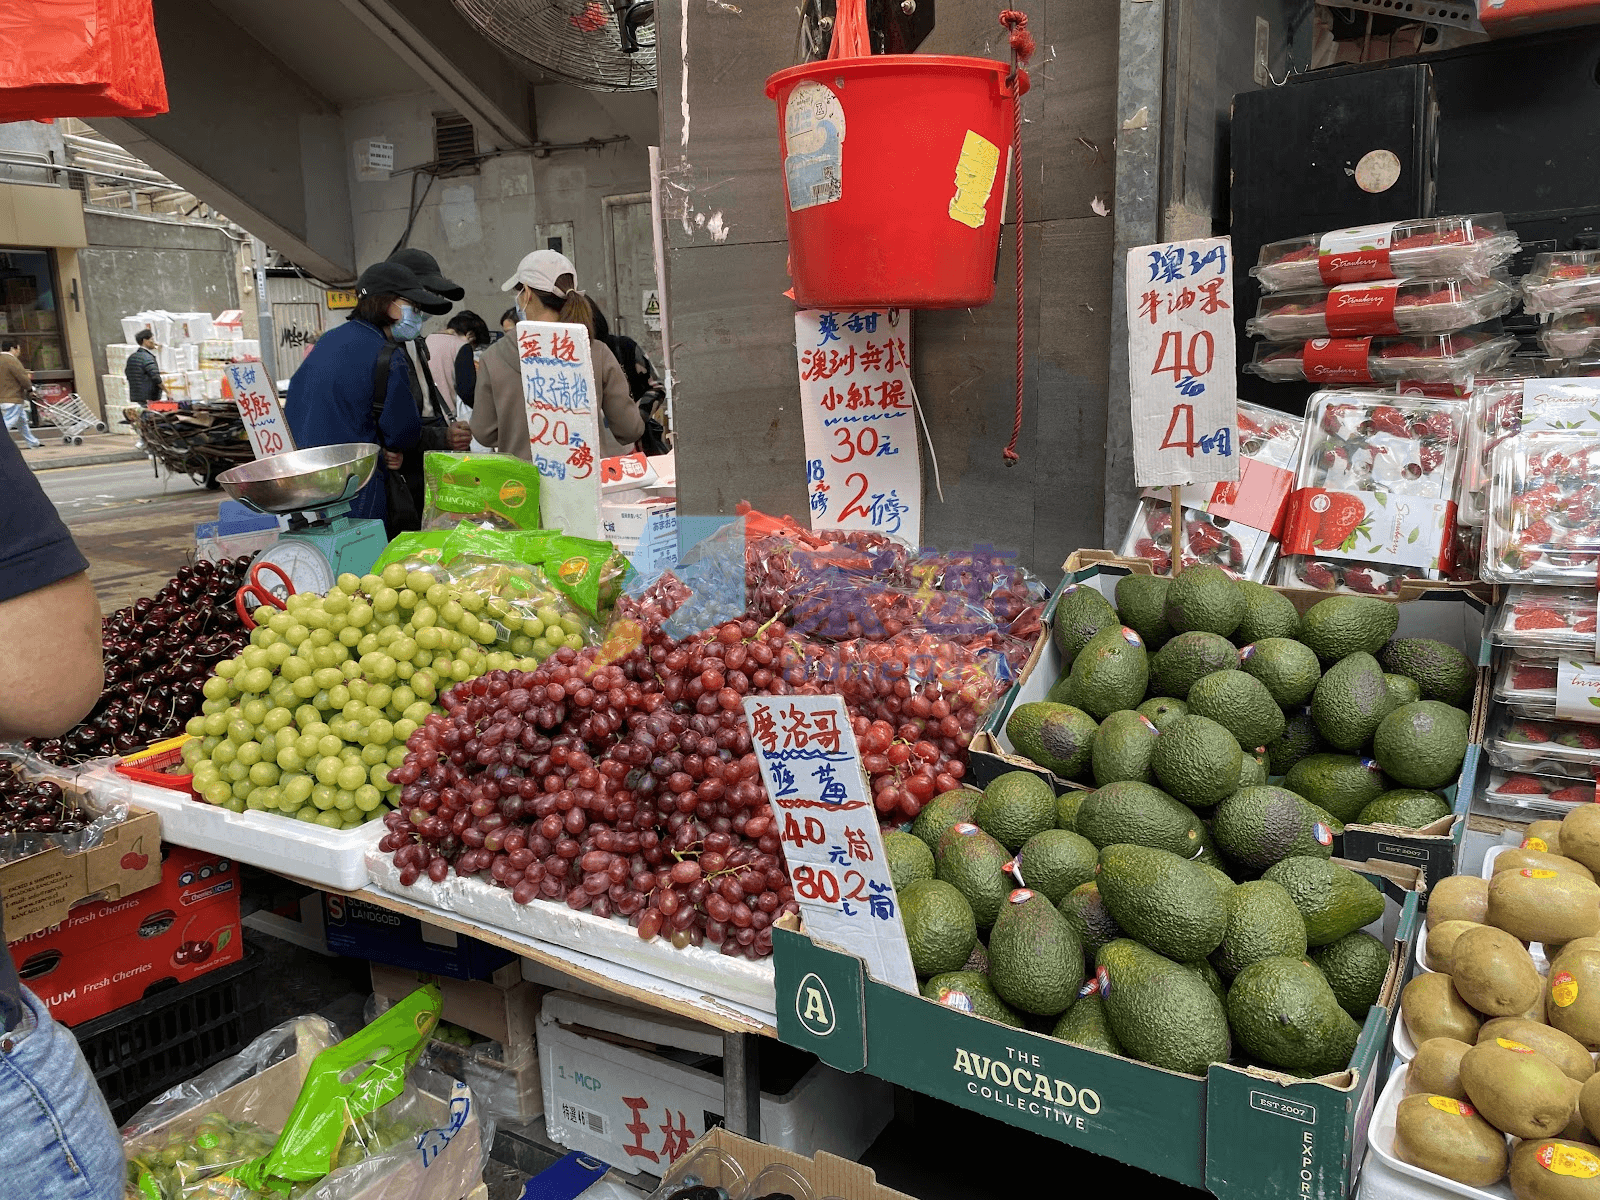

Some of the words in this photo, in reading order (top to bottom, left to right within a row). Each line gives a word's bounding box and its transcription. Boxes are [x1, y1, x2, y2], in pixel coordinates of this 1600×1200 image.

[1330, 256, 1378, 271] Strawberry
[1137, 277, 1231, 325] 牛油果
[1337, 293, 1385, 308] Strawberry
[254, 429, 283, 454] 120
[752, 703, 841, 753] 摩洛哥
[67, 911, 96, 929] Fresh
[98, 898, 140, 918] Cherries
[351, 909, 400, 926] LANDGOED
[83, 976, 110, 994] Fresh
[112, 962, 152, 983] Cherries
[803, 986, 829, 1024] A
[1005, 1046, 1041, 1068] THE
[558, 1064, 602, 1092] 1-MCP
[952, 1047, 1102, 1116] AVOCADO
[966, 1081, 1086, 1131] COLLECTIVE
[1259, 1098, 1280, 1109] EST
[1280, 1103, 1306, 1117] 2007
[621, 1096, 696, 1165] 王林
